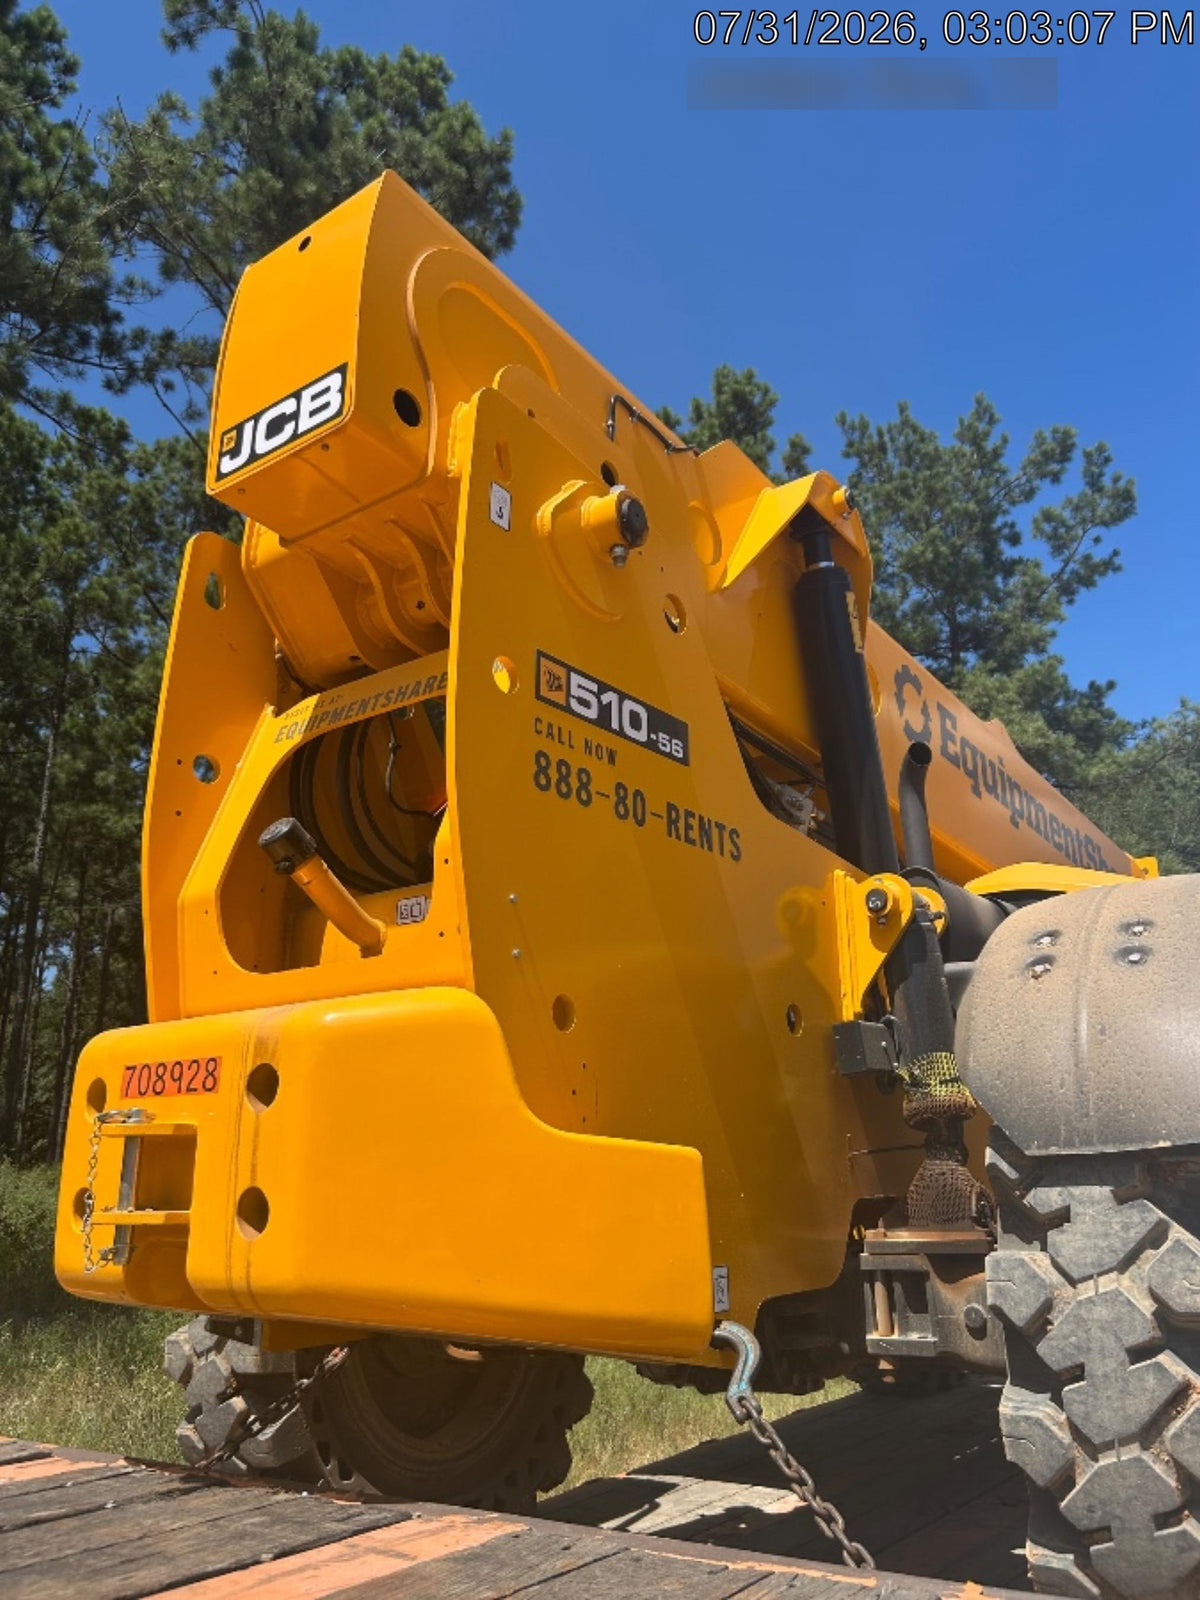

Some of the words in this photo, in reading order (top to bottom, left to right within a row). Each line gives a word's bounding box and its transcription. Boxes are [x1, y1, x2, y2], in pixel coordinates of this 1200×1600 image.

[220, 372, 343, 474] JCB
[273, 671, 449, 744] EQUIPMENTSHARE
[534, 717, 575, 750] CALL
[584, 737, 618, 767] NOW
[533, 750, 742, 862] 888-80-RENTS
[936, 702, 1115, 872] EquipmentSh
[124, 1057, 218, 1098] 708928
